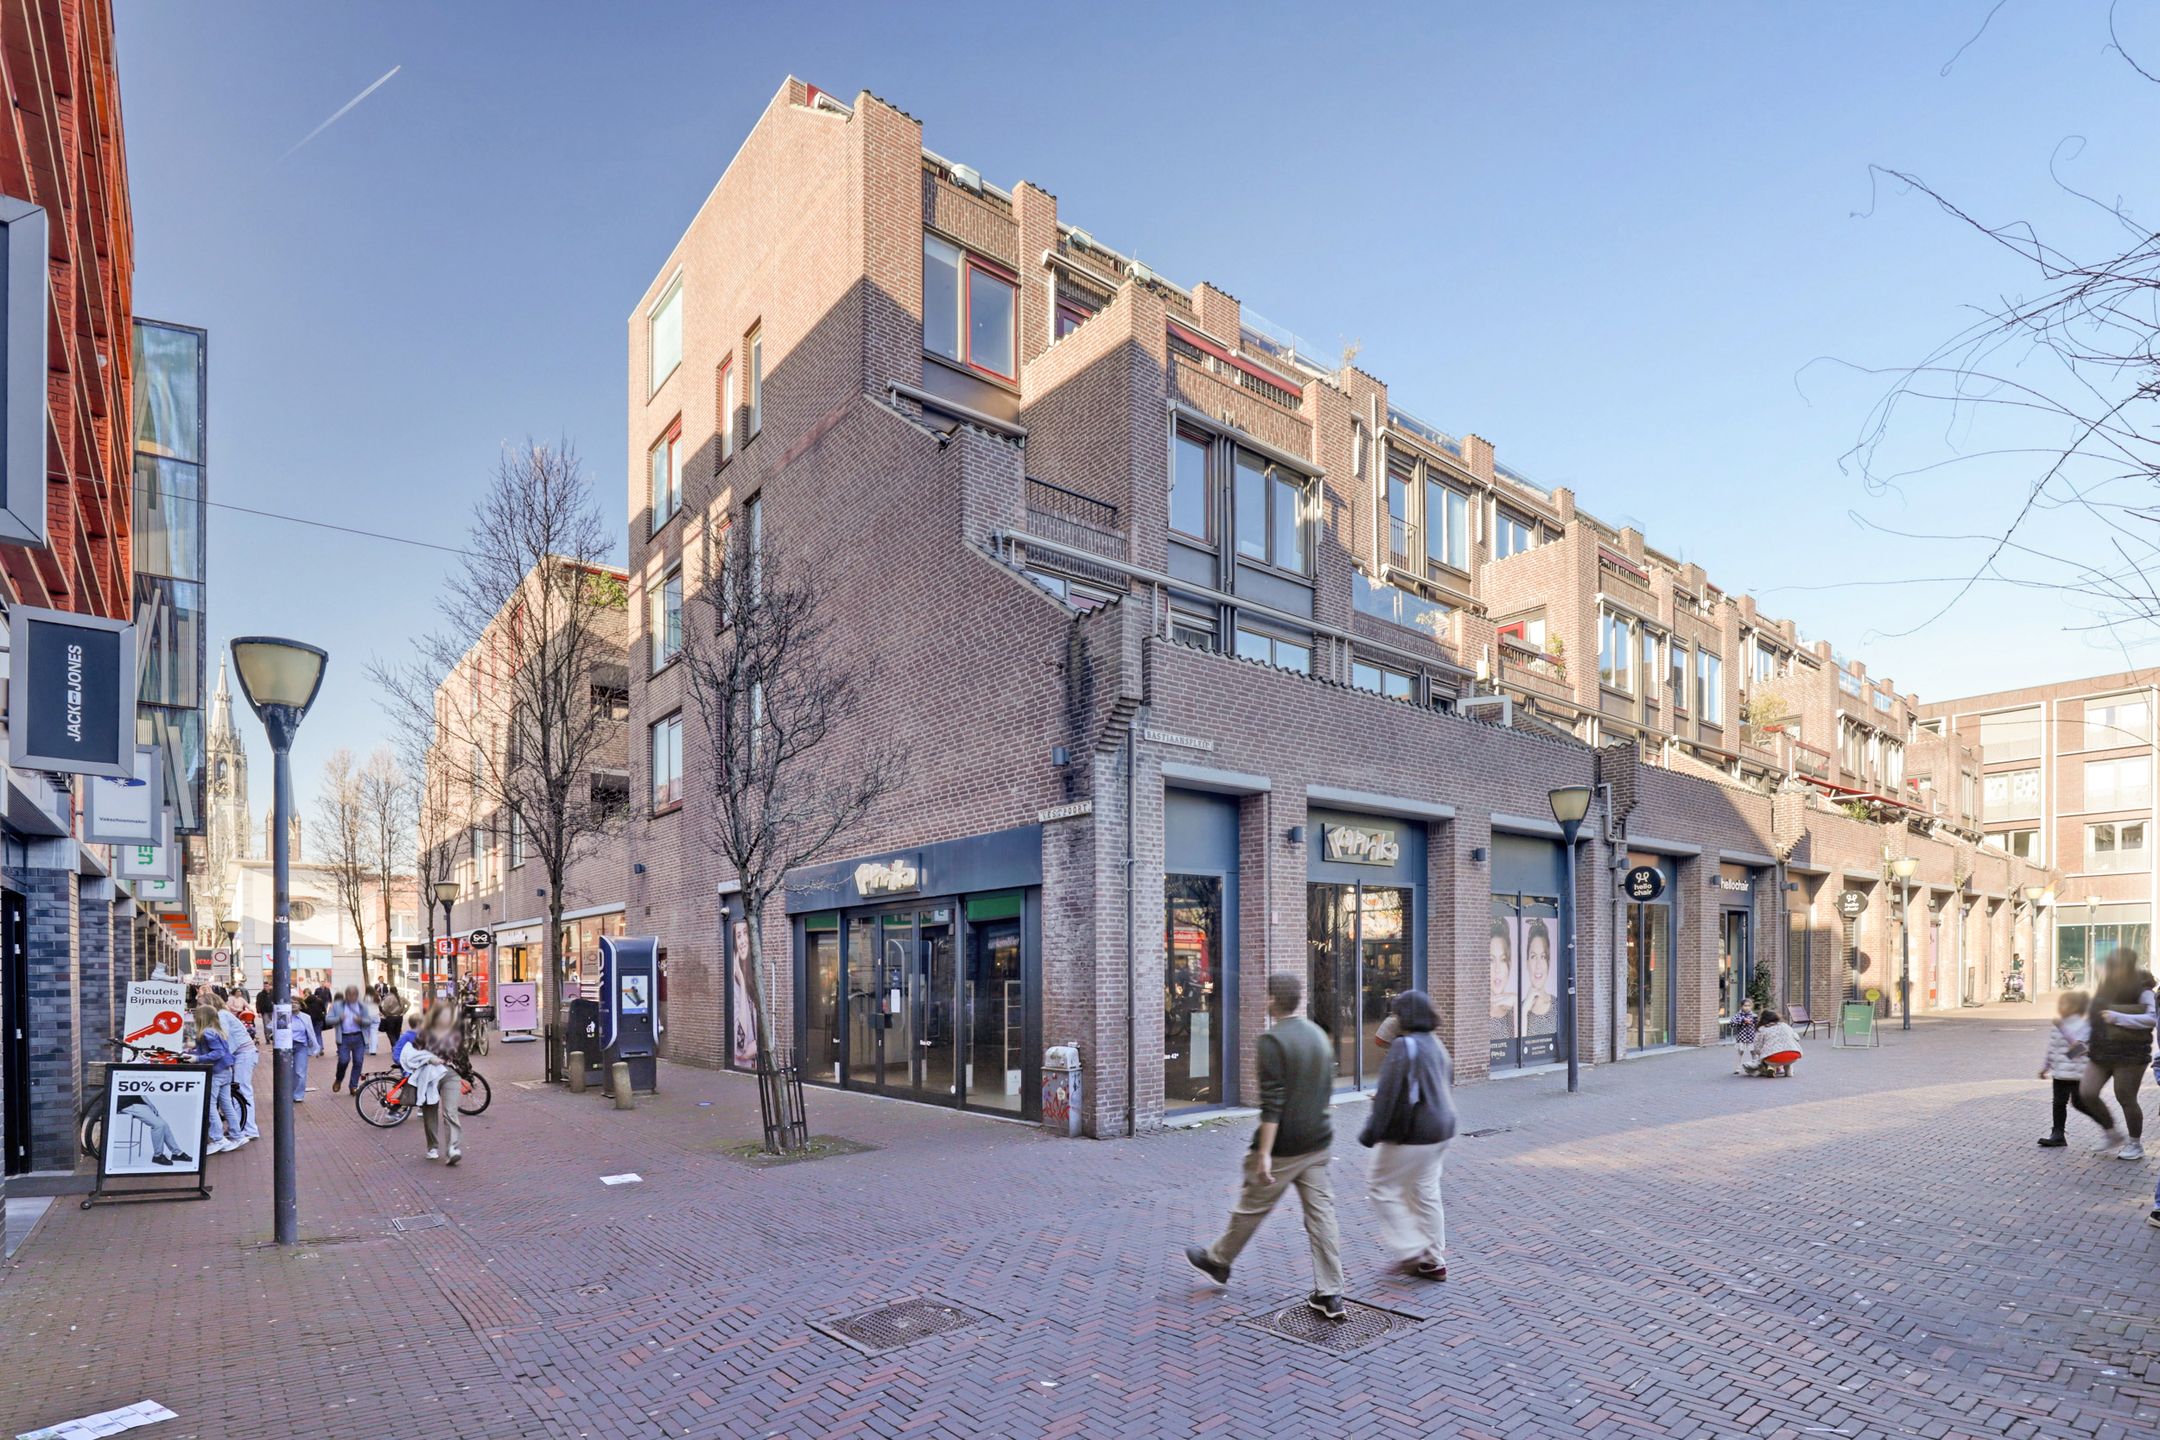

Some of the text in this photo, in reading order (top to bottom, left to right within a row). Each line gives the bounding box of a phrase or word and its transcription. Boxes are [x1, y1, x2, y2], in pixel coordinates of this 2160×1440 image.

[1326, 826, 1399, 861] Paprika
[134, 987, 179, 996] Sleutels
[130, 996, 182, 1006] Bijmaken
[118, 1081, 156, 1093] 50%
